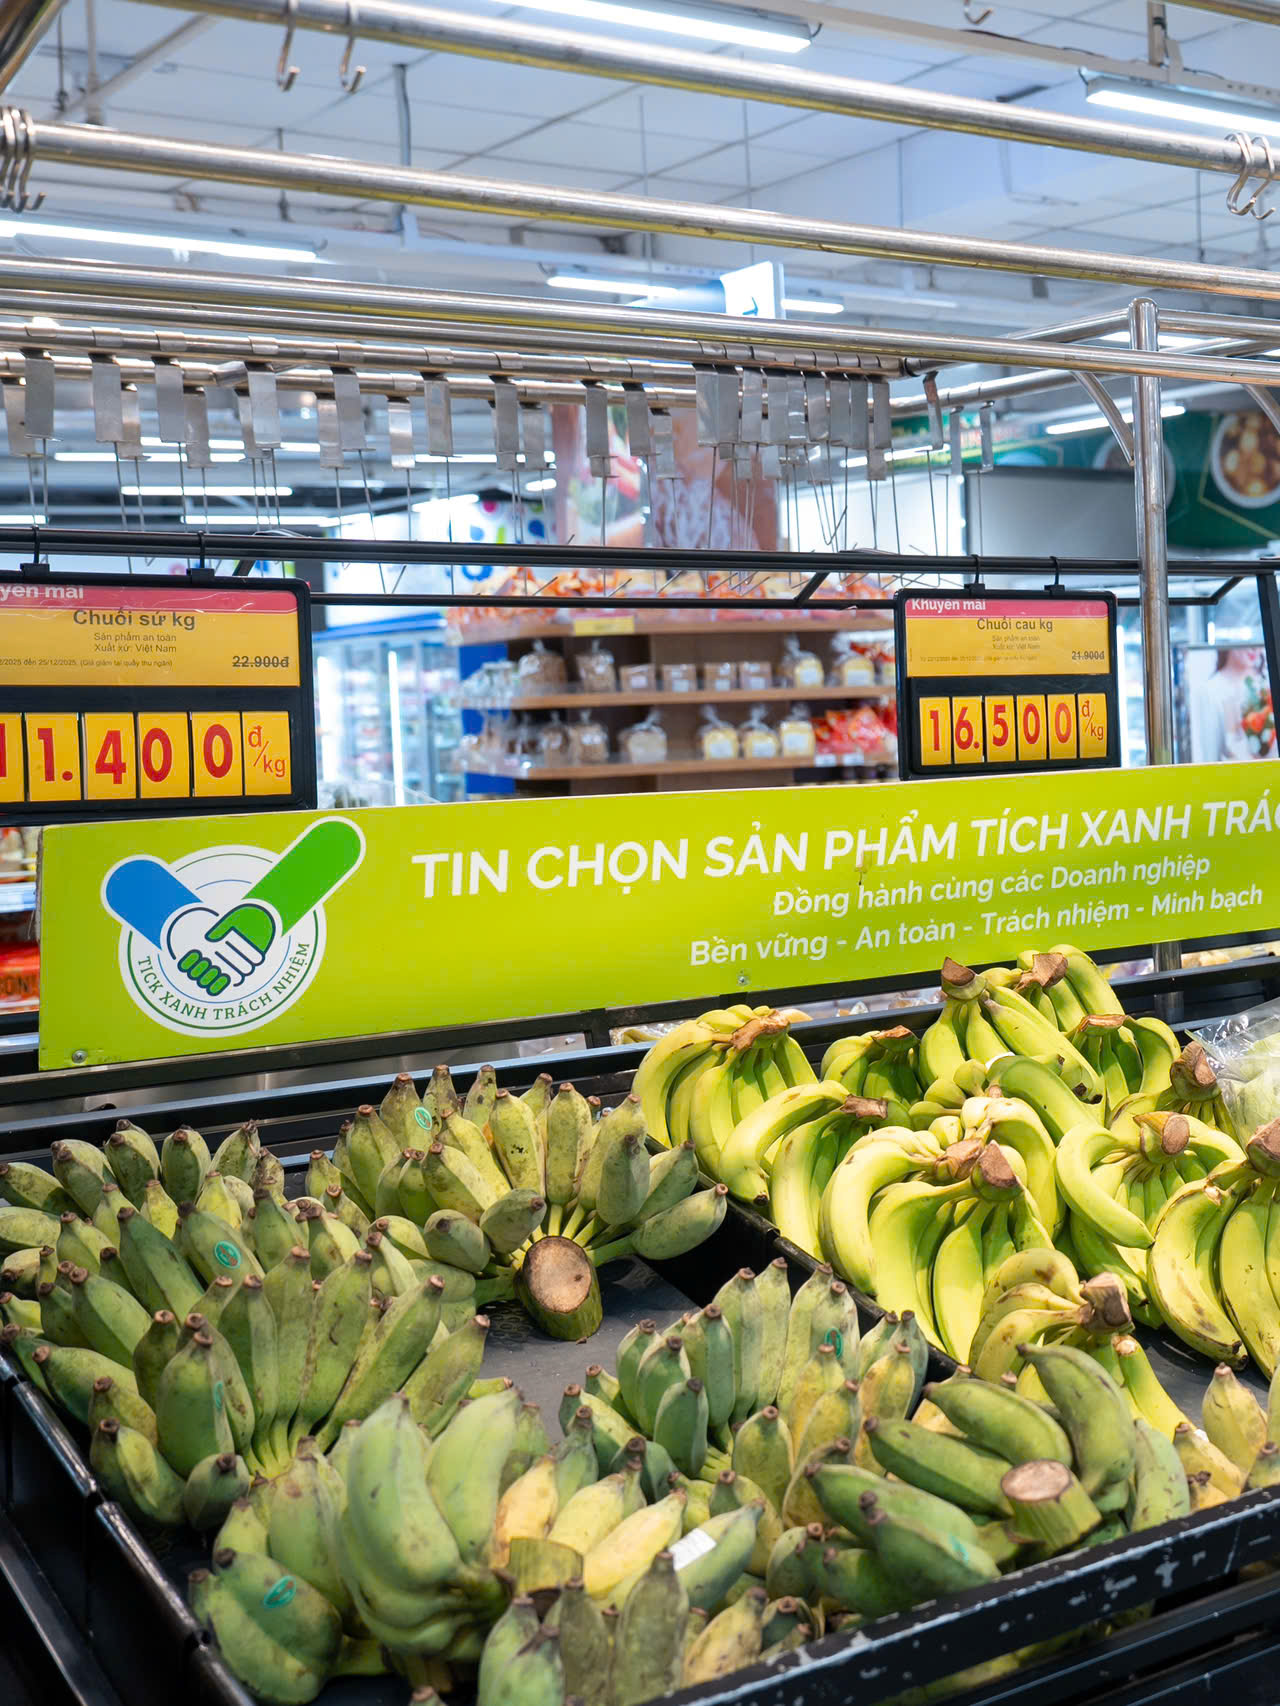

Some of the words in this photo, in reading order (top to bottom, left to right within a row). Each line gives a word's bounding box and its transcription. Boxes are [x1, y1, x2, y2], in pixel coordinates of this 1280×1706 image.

[139, 611, 165, 627] sứ
[173, 612, 196, 630] kg
[1016, 621, 1036, 630] cau
[1040, 619, 1053, 632] kg
[155, 644, 177, 652] Nam
[232, 655, 290, 669] 22.900đ
[929, 702, 1072, 751] 16.500
[411, 850, 508, 898] TIN
[527, 838, 689, 895] CHỌN
[704, 821, 808, 877] SẢN
[824, 810, 957, 870] PHẨM
[971, 808, 1068, 858] TÍCH
[1079, 804, 1192, 847] XANH
[773, 889, 849, 919] Đồng
[858, 882, 921, 909] hành
[930, 876, 994, 902] cùng
[1000, 872, 1043, 894] các
[1051, 861, 1127, 889] Doanh
[1132, 855, 1210, 887] nghiệp
[690, 937, 748, 966] Bền
[756, 930, 828, 961] vững
[855, 926, 891, 951] An
[898, 917, 955, 944] toàn
[981, 905, 1050, 937] Trách
[1056, 900, 1129, 928] nhiệm
[1151, 893, 1205, 916] Minh
[1210, 885, 1262, 915] bạch
[138, 956, 163, 994] TICK
[159, 991, 208, 1020] XANH
[213, 993, 273, 1020] TRÁCH
[272, 943, 310, 995] NHIỆM
